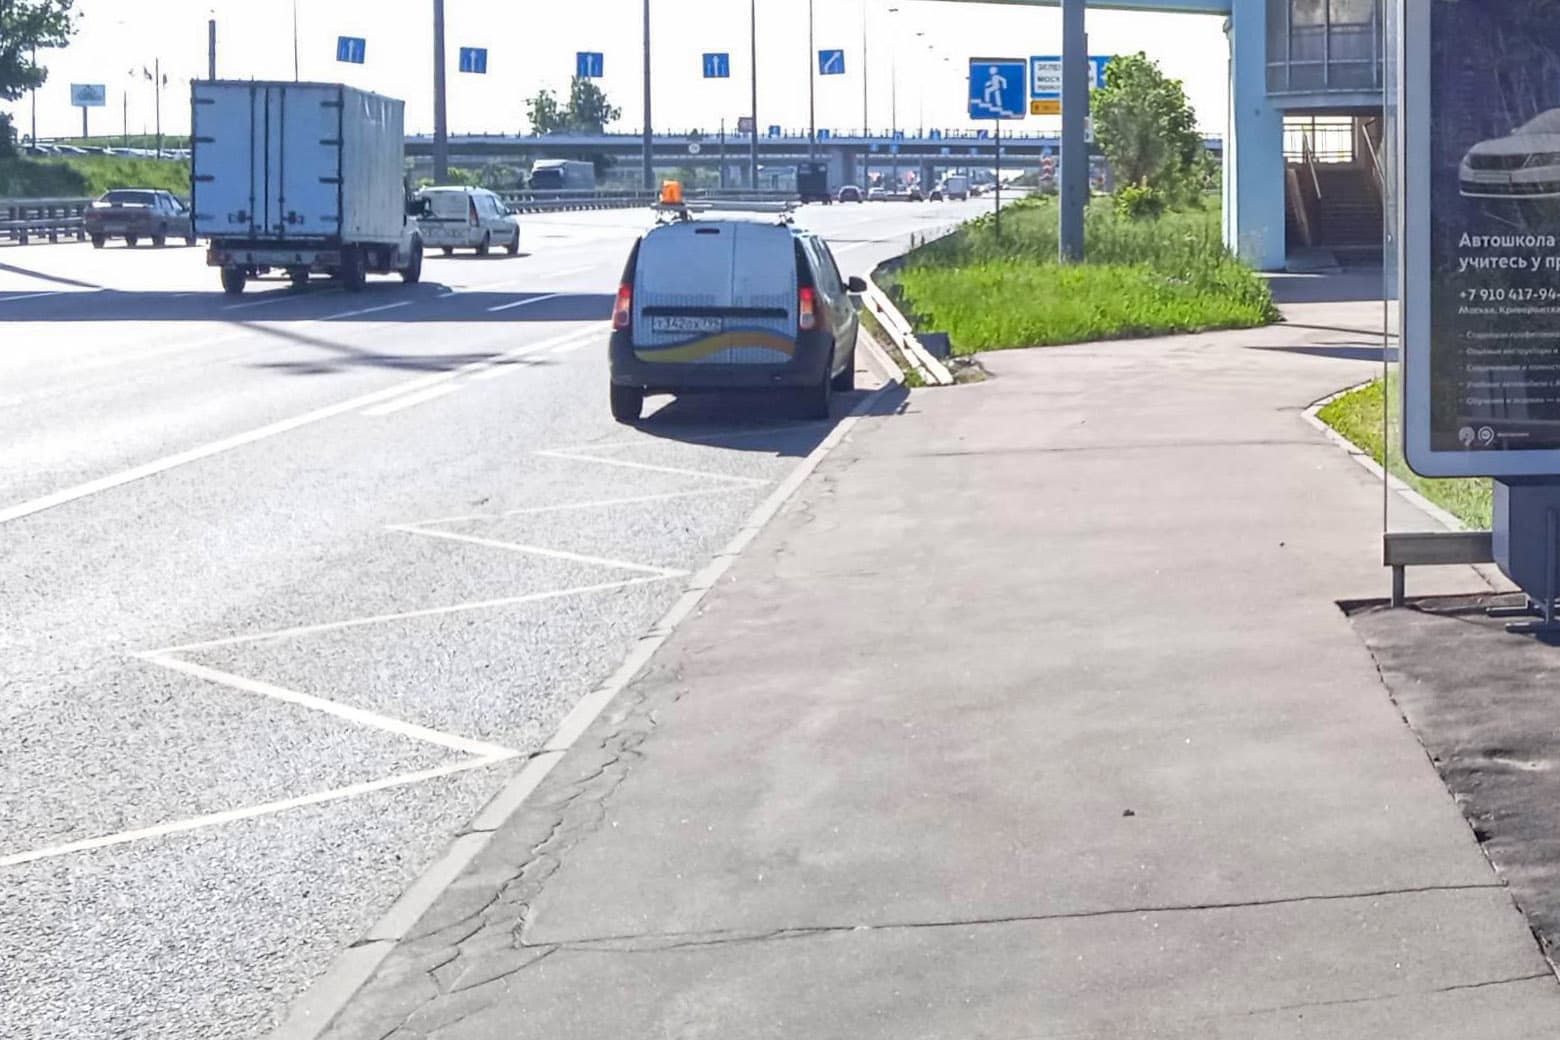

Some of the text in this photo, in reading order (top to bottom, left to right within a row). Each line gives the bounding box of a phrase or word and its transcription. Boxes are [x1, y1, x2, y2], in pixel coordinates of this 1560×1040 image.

[1459, 232, 1555, 247] Автошкола
[1458, 255, 1527, 272] учитесь
[1531, 256, 1541, 271] у
[1460, 288, 1476, 301] +7
[1480, 288, 1505, 301] 910
